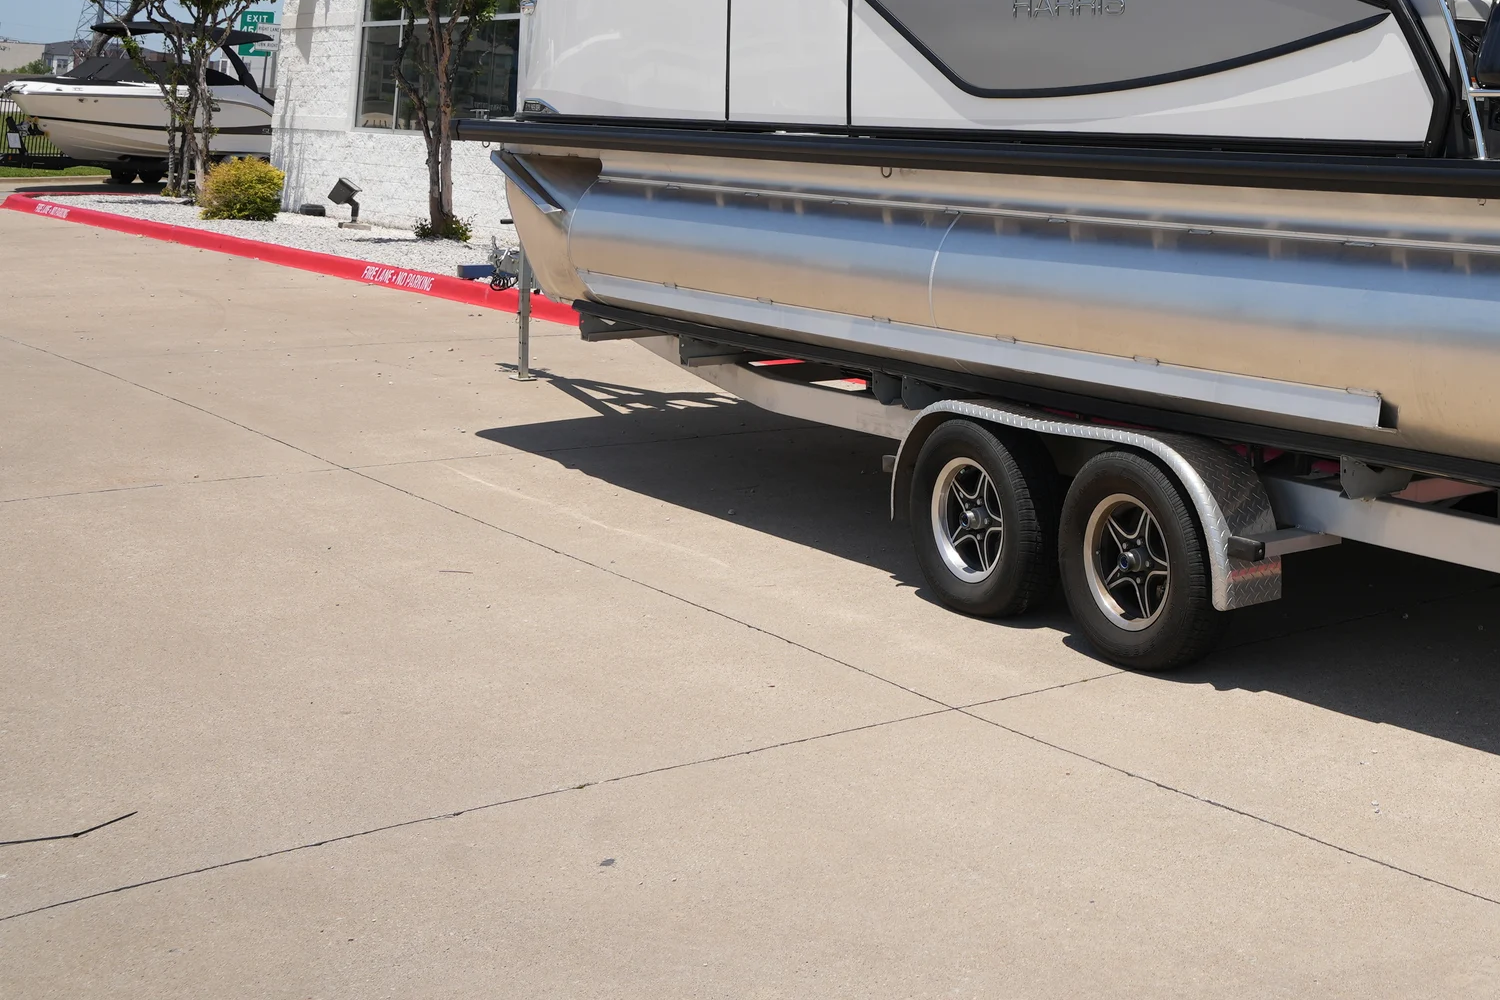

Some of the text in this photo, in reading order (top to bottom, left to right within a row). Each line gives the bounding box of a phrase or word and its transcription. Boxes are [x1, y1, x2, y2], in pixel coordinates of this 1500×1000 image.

[246, 14, 268, 23] EXIT
[361, 265, 435, 292] FIRE LANE NO PARKING
